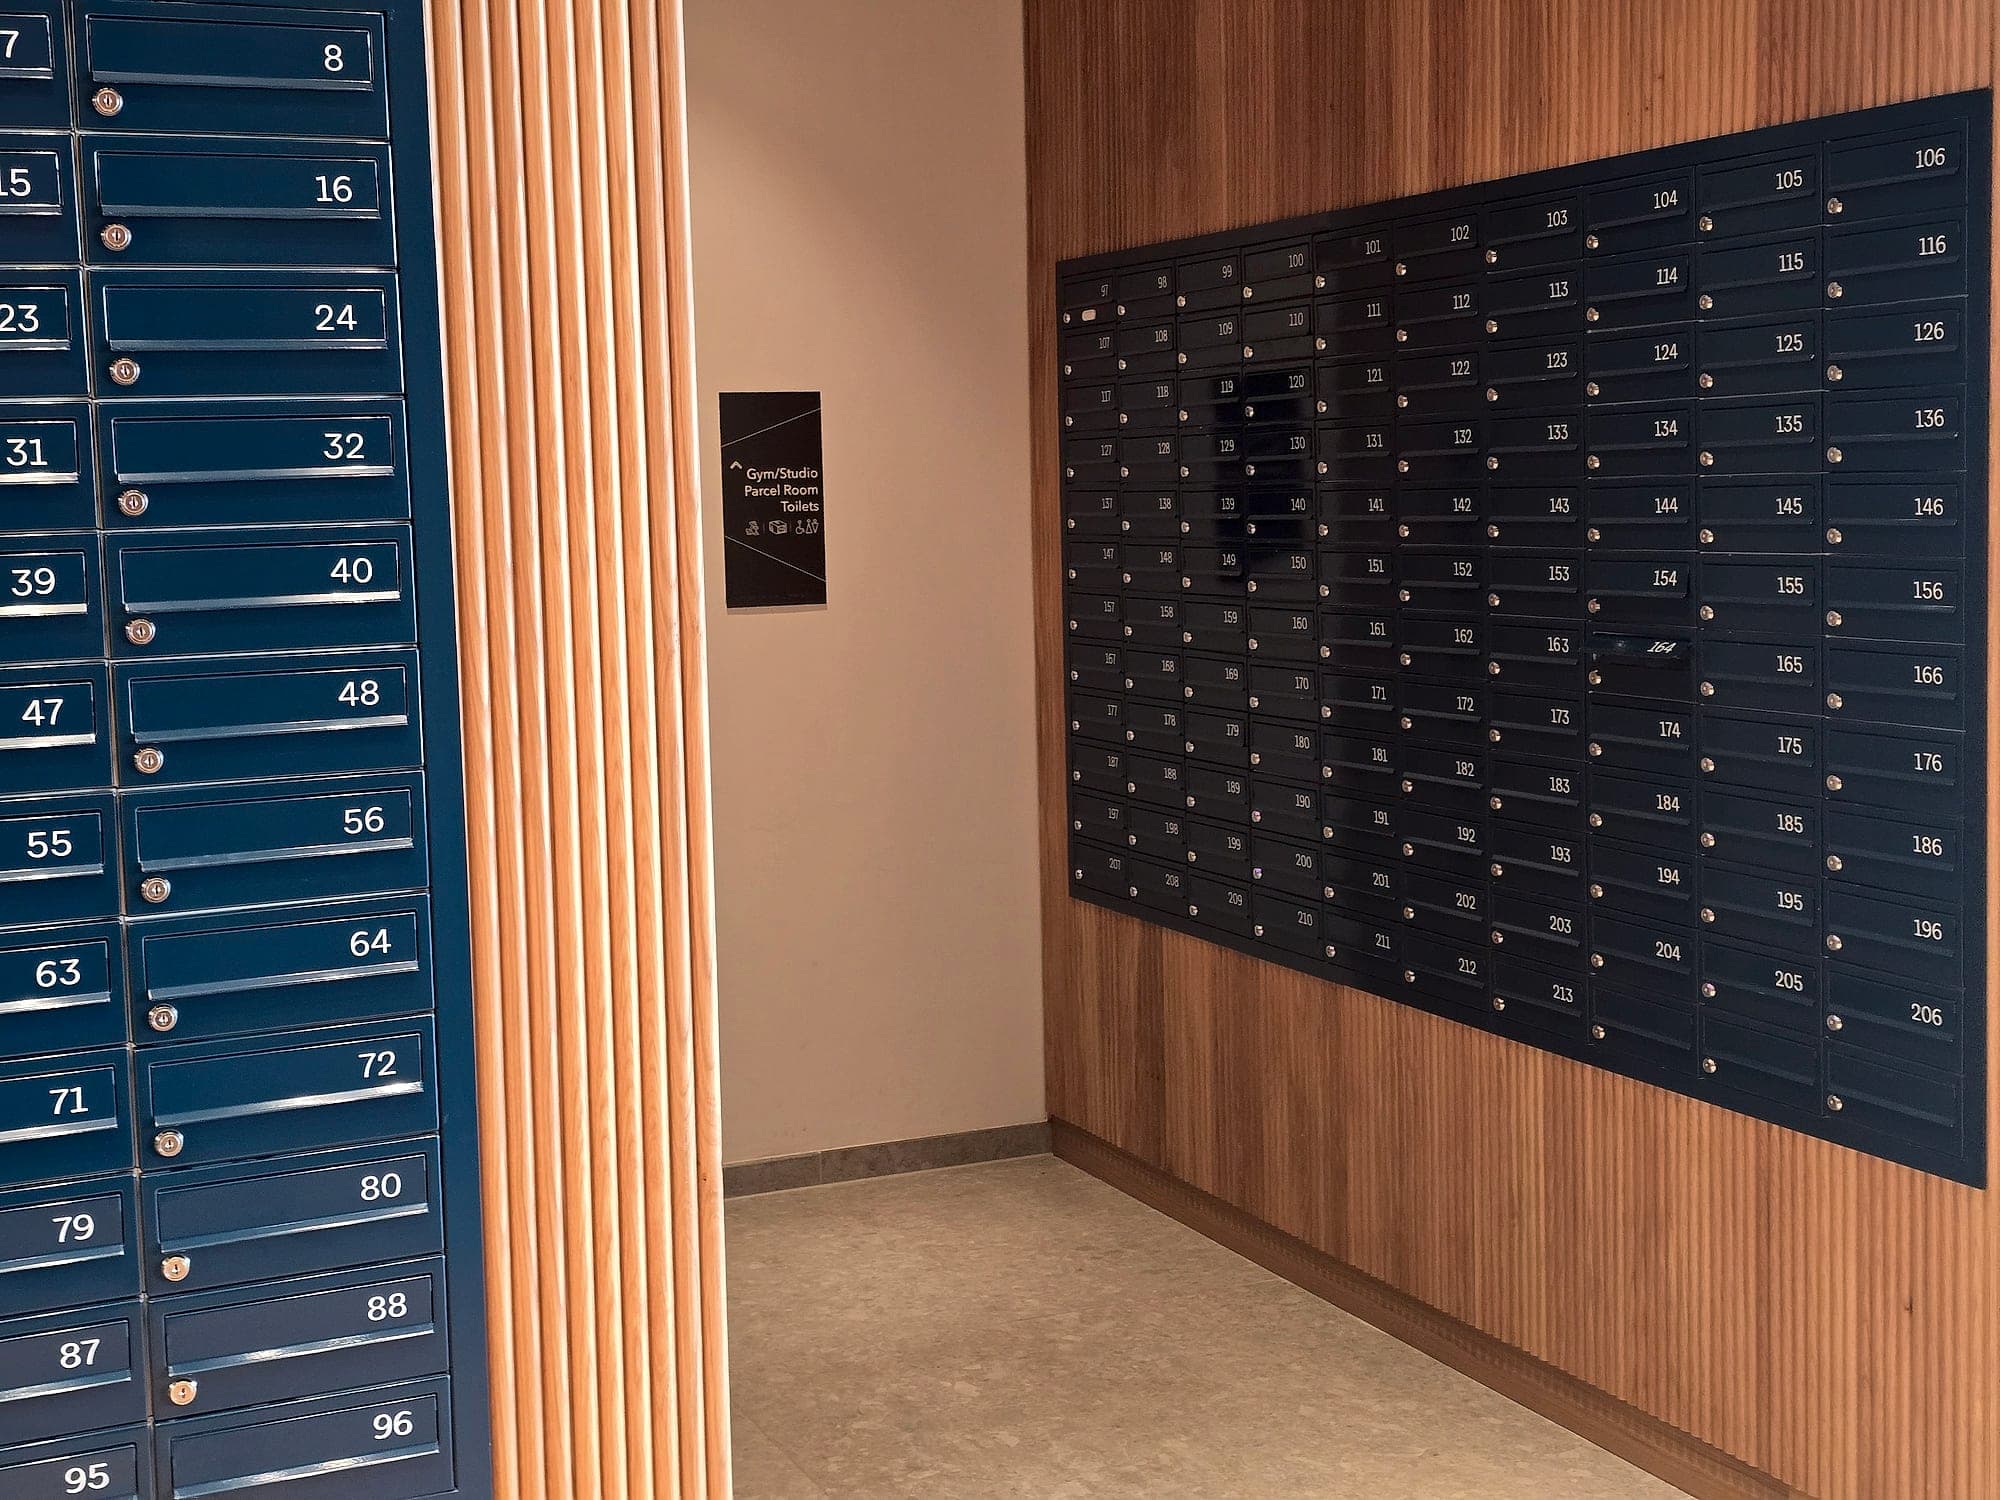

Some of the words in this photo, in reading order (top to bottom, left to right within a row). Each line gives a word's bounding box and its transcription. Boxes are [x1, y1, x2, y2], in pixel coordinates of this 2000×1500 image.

[0, 29, 20, 59] 7
[324, 44, 344, 72] 8
[1915, 147, 1946, 169] 106
[1775, 169, 1803, 190] 105
[315, 175, 353, 203] 16
[1653, 189, 1679, 210] 104
[1546, 209, 1568, 228] 103
[1450, 224, 1470, 242] 102
[1365, 239, 1382, 255] 101
[1918, 234, 1947, 256] 116
[1288, 252, 1304, 268] 100
[1778, 252, 1804, 273] 115
[1221, 264, 1233, 279] 99
[1656, 266, 1679, 286] 114
[1157, 275, 1168, 289] 98
[1548, 281, 1569, 299] 113
[1366, 302, 1382, 318] 111
[1452, 293, 1471, 310] 112
[0, 303, 39, 333] 23
[314, 304, 358, 331] 24
[1288, 312, 1304, 327] 110
[1154, 329, 1168, 343] 108
[1218, 321, 1233, 335] 109
[1914, 321, 1945, 342] 126
[1775, 333, 1803, 353] 125
[1546, 351, 1568, 369] 123
[1654, 343, 1679, 361] 124
[1366, 367, 1384, 383] 121
[1450, 360, 1471, 376] 122
[1220, 379, 1234, 394] 119
[1288, 374, 1305, 389] 120
[1156, 385, 1170, 398] 118
[1775, 414, 1803, 433] 135
[1914, 408, 1945, 428] 136
[1453, 428, 1473, 445] 132
[1547, 423, 1569, 441] 133
[1654, 419, 1679, 437] 134
[323, 432, 365, 460] 32
[1157, 441, 1171, 455] 128
[1219, 439, 1235, 453] 129
[1290, 436, 1306, 450] 130
[1366, 433, 1384, 448] 131
[6, 438, 48, 467] 31
[746, 466, 819, 483] Gym/Studio
[744, 483, 781, 497] Parcel
[783, 484, 819, 496] Room
[780, 499, 820, 513] Toilets
[1158, 497, 1172, 510] 138
[1220, 497, 1235, 511] 139
[1290, 497, 1306, 511] 140
[1368, 497, 1385, 512] 141
[1452, 497, 1472, 512] 142
[1549, 497, 1570, 514] 143
[1654, 497, 1679, 514] 144
[1775, 497, 1803, 515] 145
[1914, 497, 1944, 516] 146
[1159, 551, 1173, 564] 148
[1222, 553, 1237, 566] 149
[1290, 555, 1307, 570] 150
[1367, 558, 1385, 573] 151
[330, 557, 373, 584] 40
[1453, 561, 1473, 577] 152
[1548, 565, 1570, 582] 153
[11, 567, 56, 597] 39
[1652, 570, 1678, 587] 154
[1777, 576, 1804, 595] 155
[1913, 581, 1944, 600] 156
[1160, 605, 1174, 618] 158
[1223, 610, 1238, 624] 159
[1292, 616, 1308, 630] 160
[1369, 621, 1387, 636] 161
[1454, 628, 1474, 644] 162
[1547, 636, 1570, 653] 163
[1646, 641, 1677, 654] 164
[1161, 659, 1175, 673] 168
[1776, 655, 1803, 674] 165
[1224, 667, 1239, 681] 169
[1913, 665, 1943, 685] 166
[1294, 676, 1310, 690] 170
[337, 679, 380, 707] 48
[1371, 685, 1387, 701] 171
[1456, 695, 1475, 712] 172
[21, 698, 64, 727] 47
[1163, 713, 1177, 727] 178
[1550, 708, 1570, 725] 173
[1226, 723, 1240, 737] 179
[1659, 721, 1682, 739] 174
[1294, 734, 1310, 750] 180
[1777, 736, 1803, 755] 175
[1371, 747, 1389, 763] 181
[1913, 752, 1943, 772] 176
[1163, 767, 1178, 781] 188
[1455, 760, 1475, 777] 182
[1226, 780, 1241, 794] 189
[1549, 776, 1571, 794] 183
[1295, 793, 1311, 809] 190
[1656, 794, 1681, 812] 184
[343, 806, 385, 835] 56
[1372, 810, 1390, 826] 191
[1776, 813, 1804, 834] 185
[1164, 821, 1179, 835] 198
[1457, 826, 1476, 843] 192
[26, 829, 73, 859] 55
[1227, 836, 1242, 851] 199
[1912, 835, 1943, 856] 186
[1295, 853, 1313, 869] 200
[1550, 845, 1571, 863] 193
[1165, 873, 1180, 888] 208
[1372, 872, 1391, 889] 201
[1657, 866, 1681, 885] 194
[1227, 891, 1243, 906] 209
[1455, 892, 1477, 910] 202
[1776, 891, 1804, 911] 195
[1297, 910, 1313, 927] 210
[1549, 915, 1572, 934] 203
[1913, 919, 1943, 941] 196
[350, 928, 392, 957] 64
[1375, 933, 1391, 950] 211
[1655, 941, 1682, 962] 204
[35, 958, 81, 988] 63
[1458, 957, 1477, 975] 212
[1774, 970, 1804, 992] 205
[1552, 984, 1574, 1003] 213
[1911, 1002, 1943, 1026] 206
[358, 1050, 397, 1078] 72
[48, 1086, 89, 1115] 71
[360, 1172, 402, 1201] 80
[52, 1213, 95, 1243] 79
[367, 1292, 408, 1322] 88
[60, 1338, 101, 1369] 87
[372, 1410, 413, 1440] 96
[64, 1462, 110, 1494] 95
